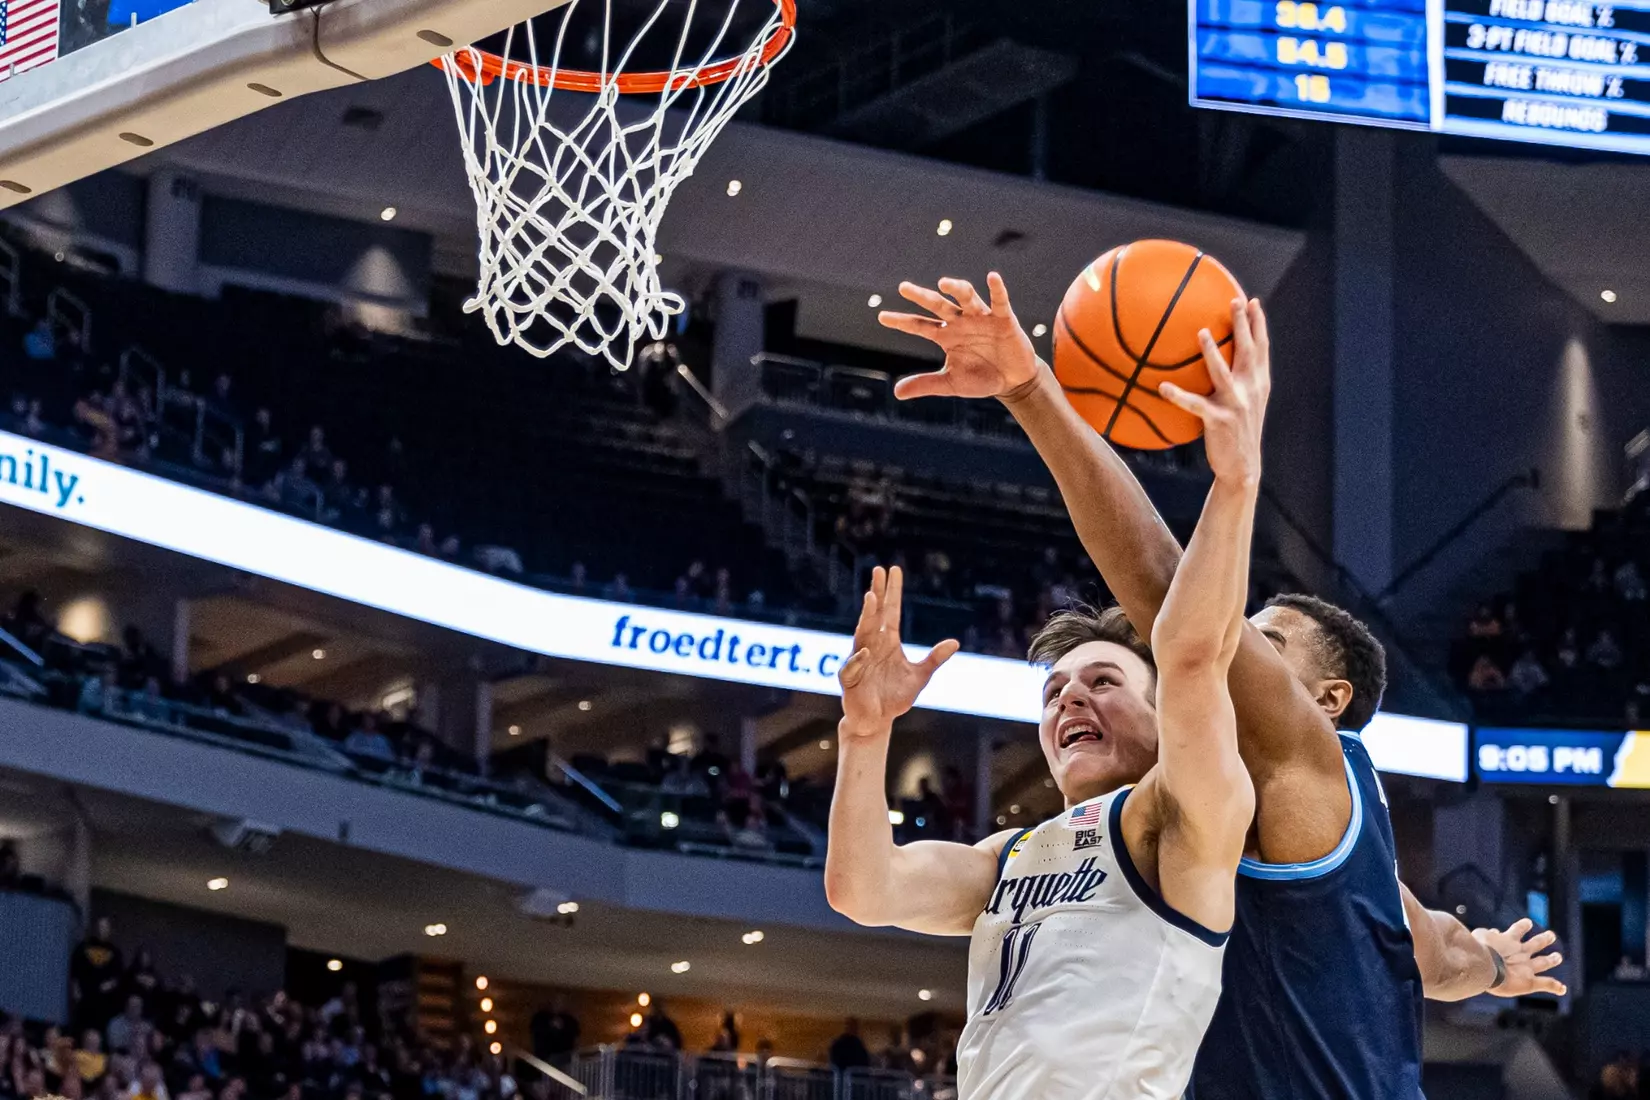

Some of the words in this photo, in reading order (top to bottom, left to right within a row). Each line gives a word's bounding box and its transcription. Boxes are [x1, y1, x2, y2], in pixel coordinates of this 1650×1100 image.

[1513, 28, 1568, 58] FIELD
[1568, 33, 1619, 64] GOAL
[1619, 40, 1638, 64] %
[1484, 61, 1533, 90] FREE
[1533, 66, 1605, 97] THROW
[1606, 75, 1624, 98] %
[1502, 99, 1608, 133] REBOUNDS
[612, 615, 841, 677] froedtert.c
[1553, 747, 1603, 774] PM
[1074, 836, 1103, 848] EAST
[1075, 829, 1097, 839] BIG
[984, 856, 1108, 924] rquette
[983, 923, 1042, 1016] 11
